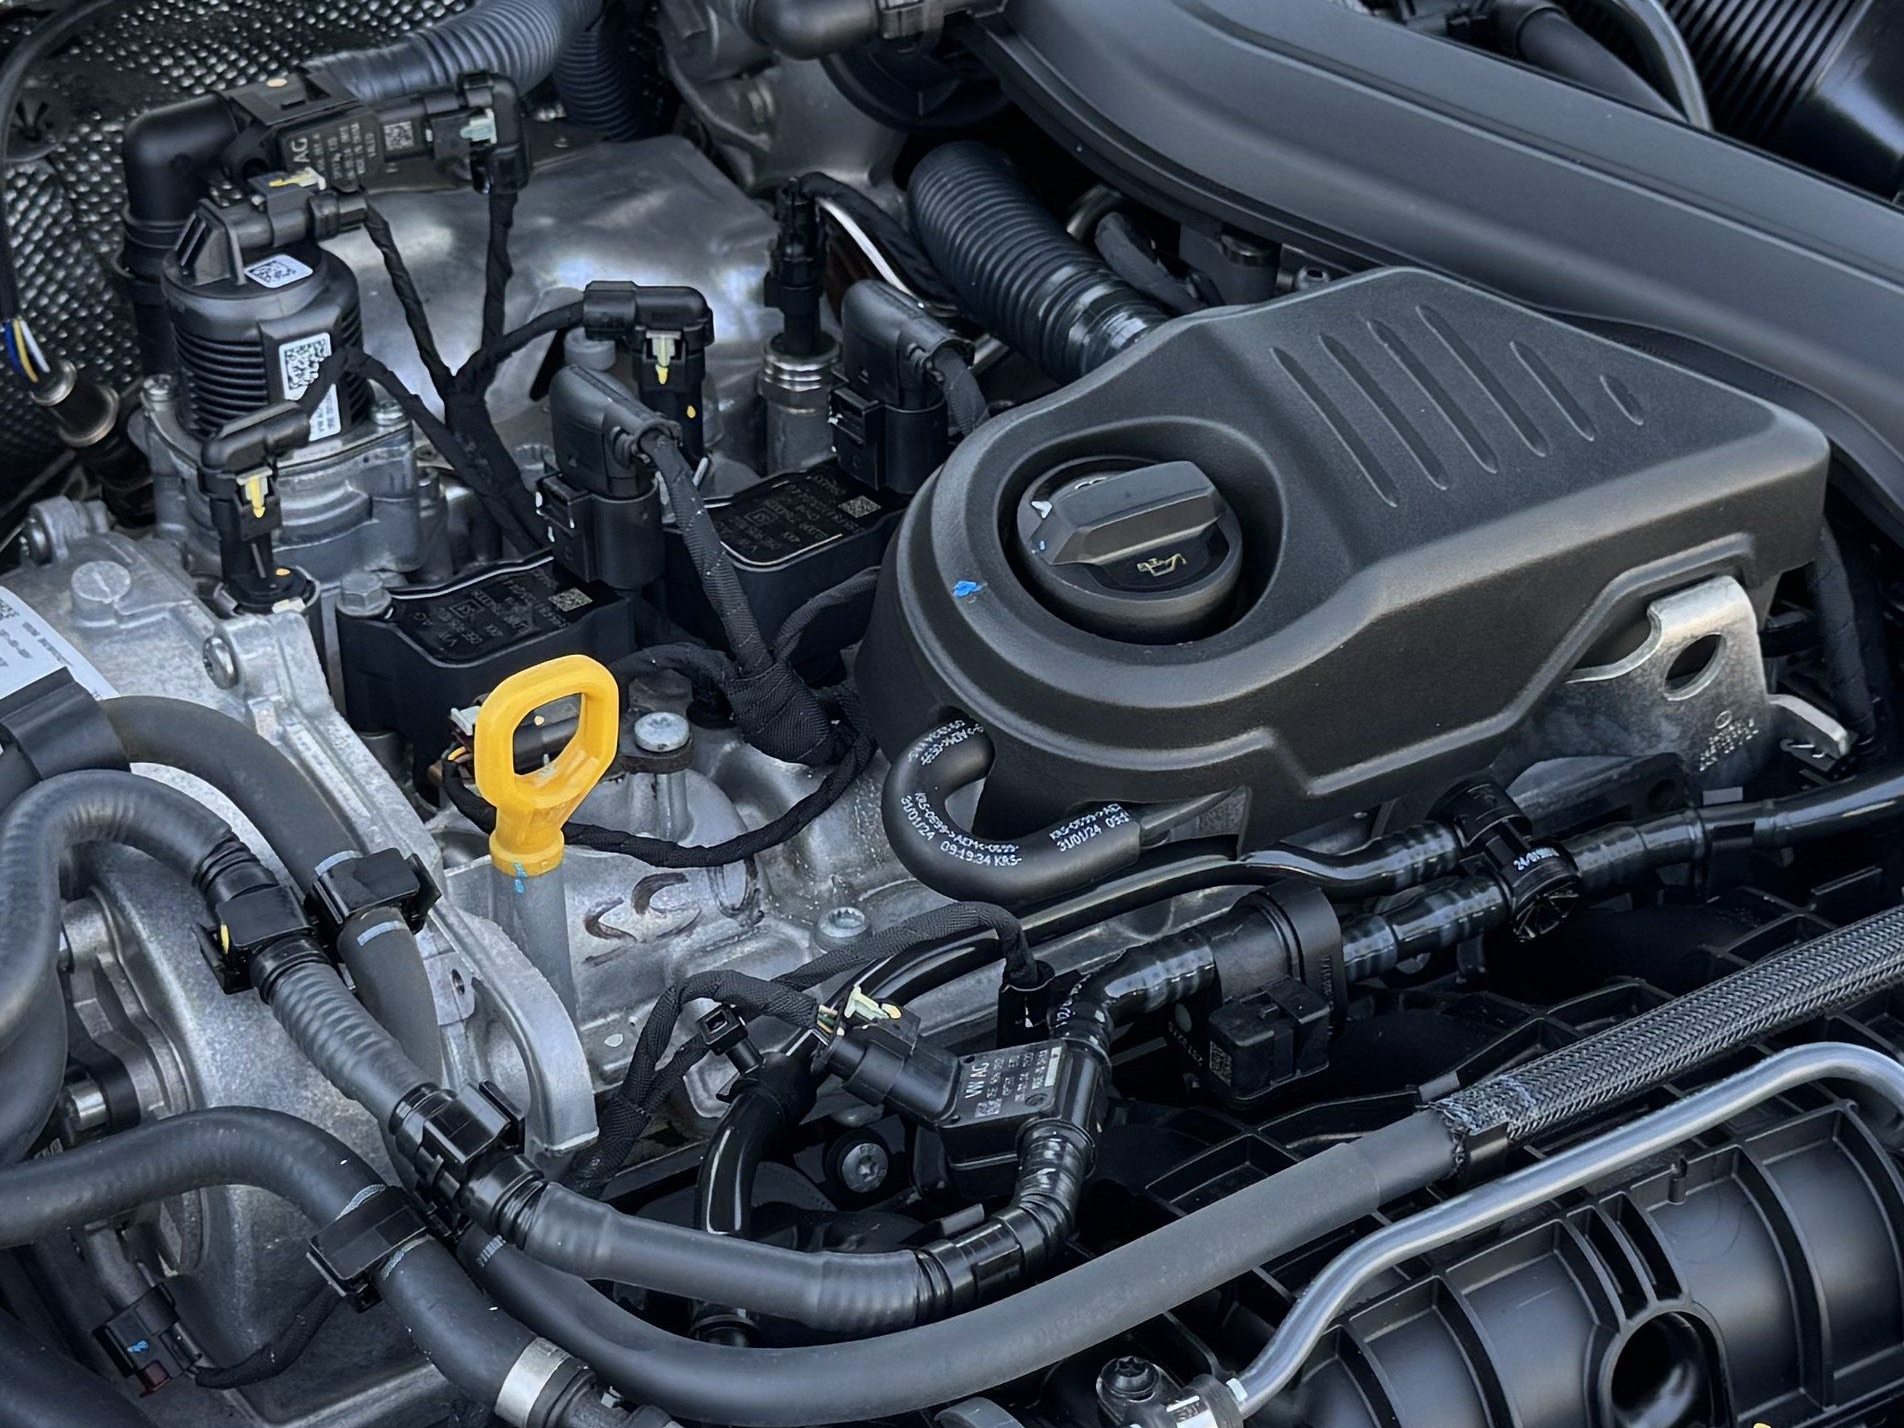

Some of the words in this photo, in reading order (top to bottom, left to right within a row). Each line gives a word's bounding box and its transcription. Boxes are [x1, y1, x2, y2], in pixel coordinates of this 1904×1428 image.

[291, 138, 311, 163] AG
[969, 1061, 990, 1078] AG
[964, 1079, 985, 1098] VW
